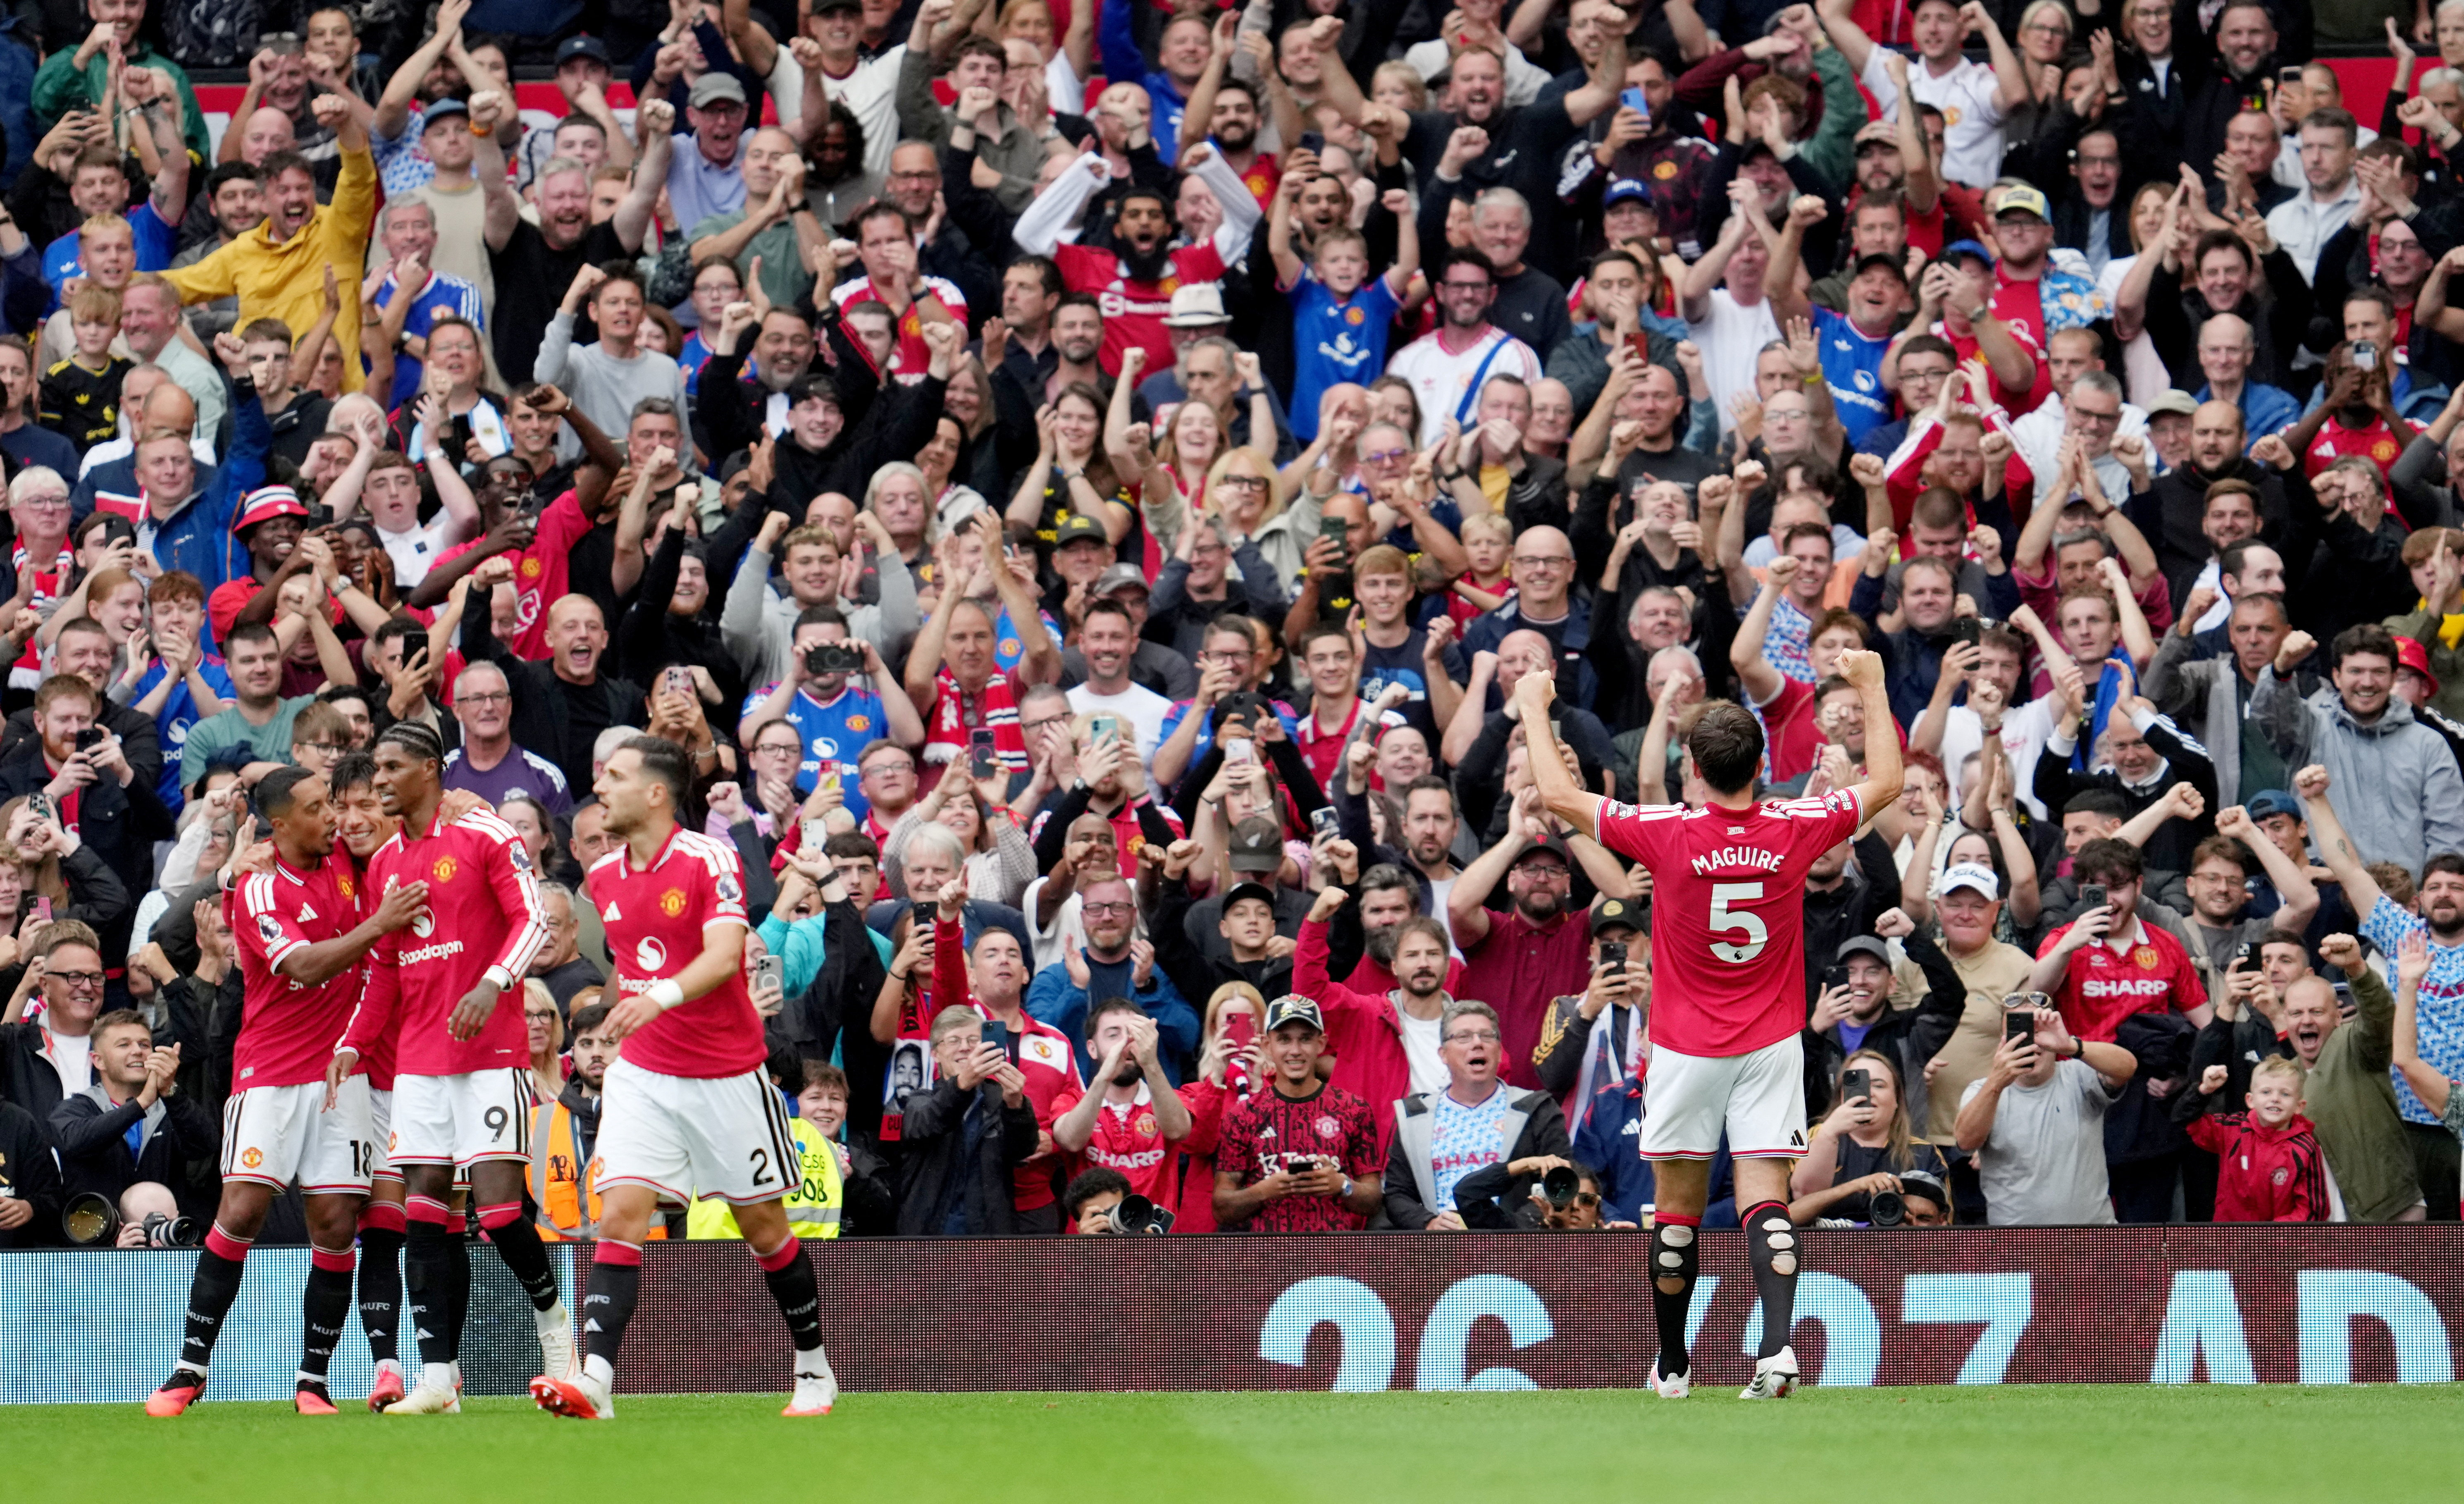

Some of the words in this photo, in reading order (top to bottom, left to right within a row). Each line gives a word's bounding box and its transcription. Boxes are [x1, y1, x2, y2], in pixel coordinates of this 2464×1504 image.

[1691, 846, 1785, 876] MAGUIRE
[1709, 882, 1767, 963] 5
[617, 973, 670, 996] Snapd
[2083, 979, 2168, 997] SHARP
[484, 1106, 508, 1142] 9
[350, 1140, 372, 1177] 18
[750, 1148, 774, 1186] 2
[802, 1155, 825, 1169] CSG
[1085, 1145, 1164, 1169] SHARP
[1431, 1152, 1500, 1170] SHAR
[187, 1308, 214, 1325] MUFC
[360, 1302, 390, 1311] MUFC
